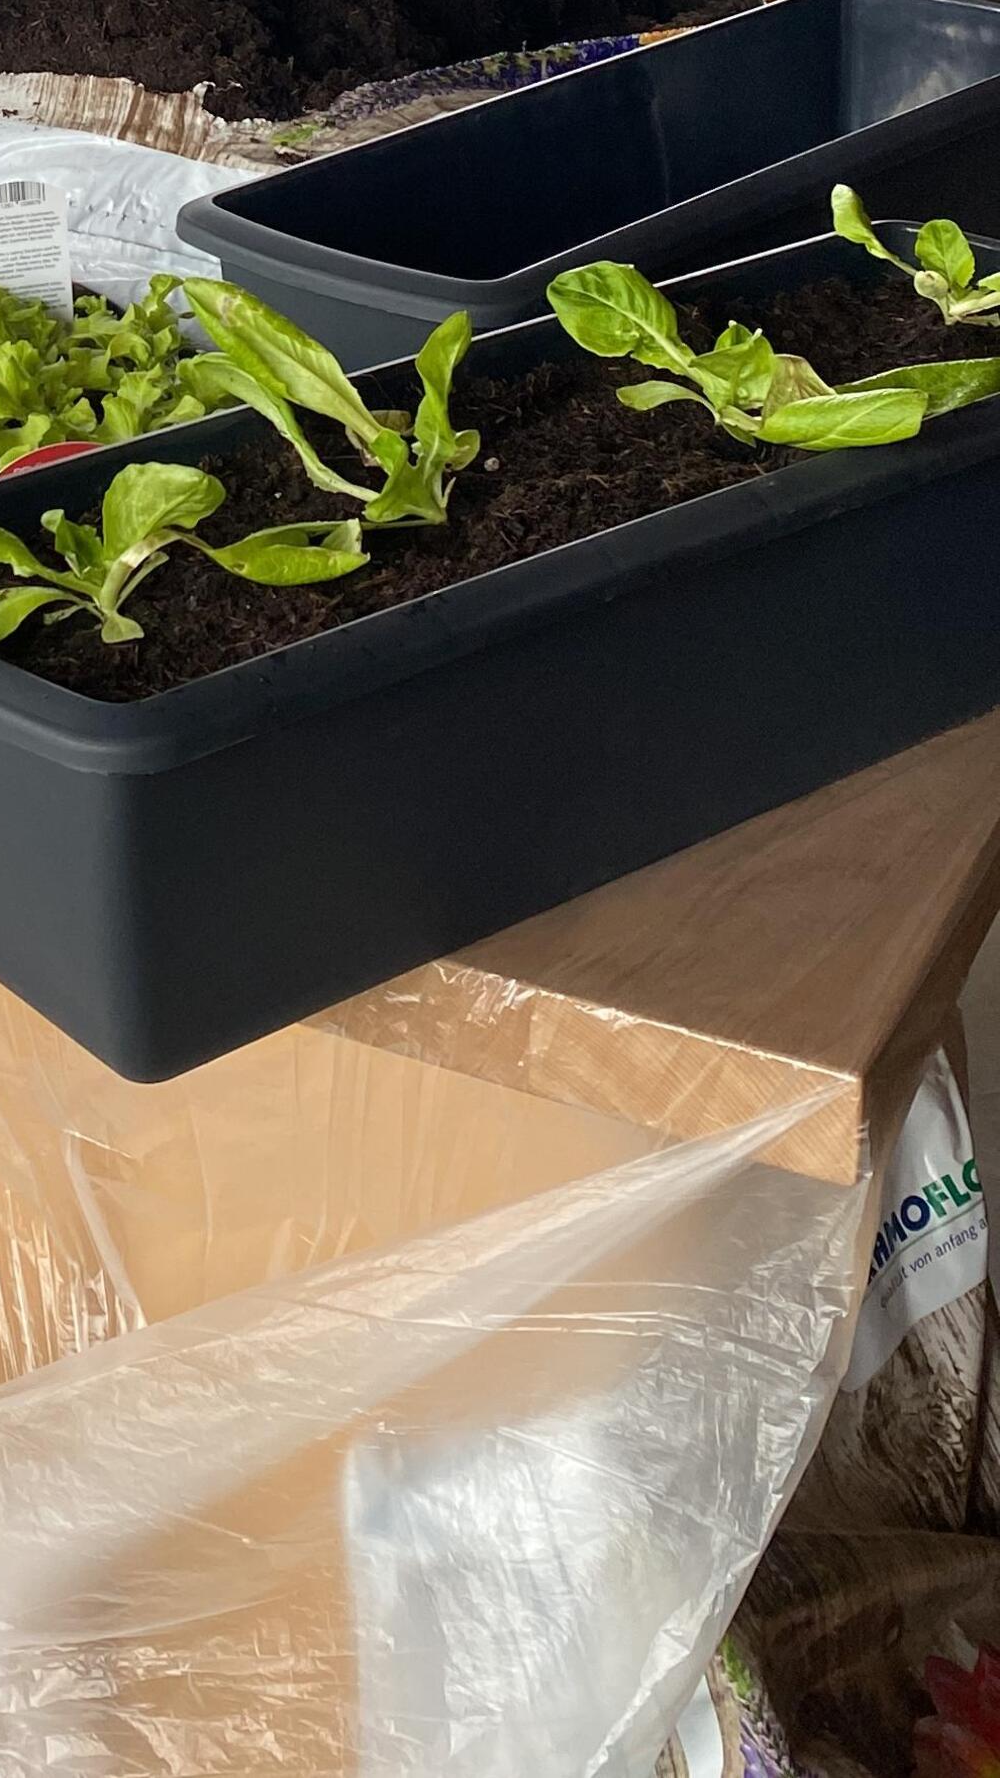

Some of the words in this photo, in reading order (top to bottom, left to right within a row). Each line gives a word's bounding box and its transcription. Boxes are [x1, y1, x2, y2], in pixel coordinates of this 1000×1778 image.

[868, 1158, 983, 1285] AMOFLO
[909, 1251, 932, 1273] von
[935, 1225, 978, 1257] anfang
